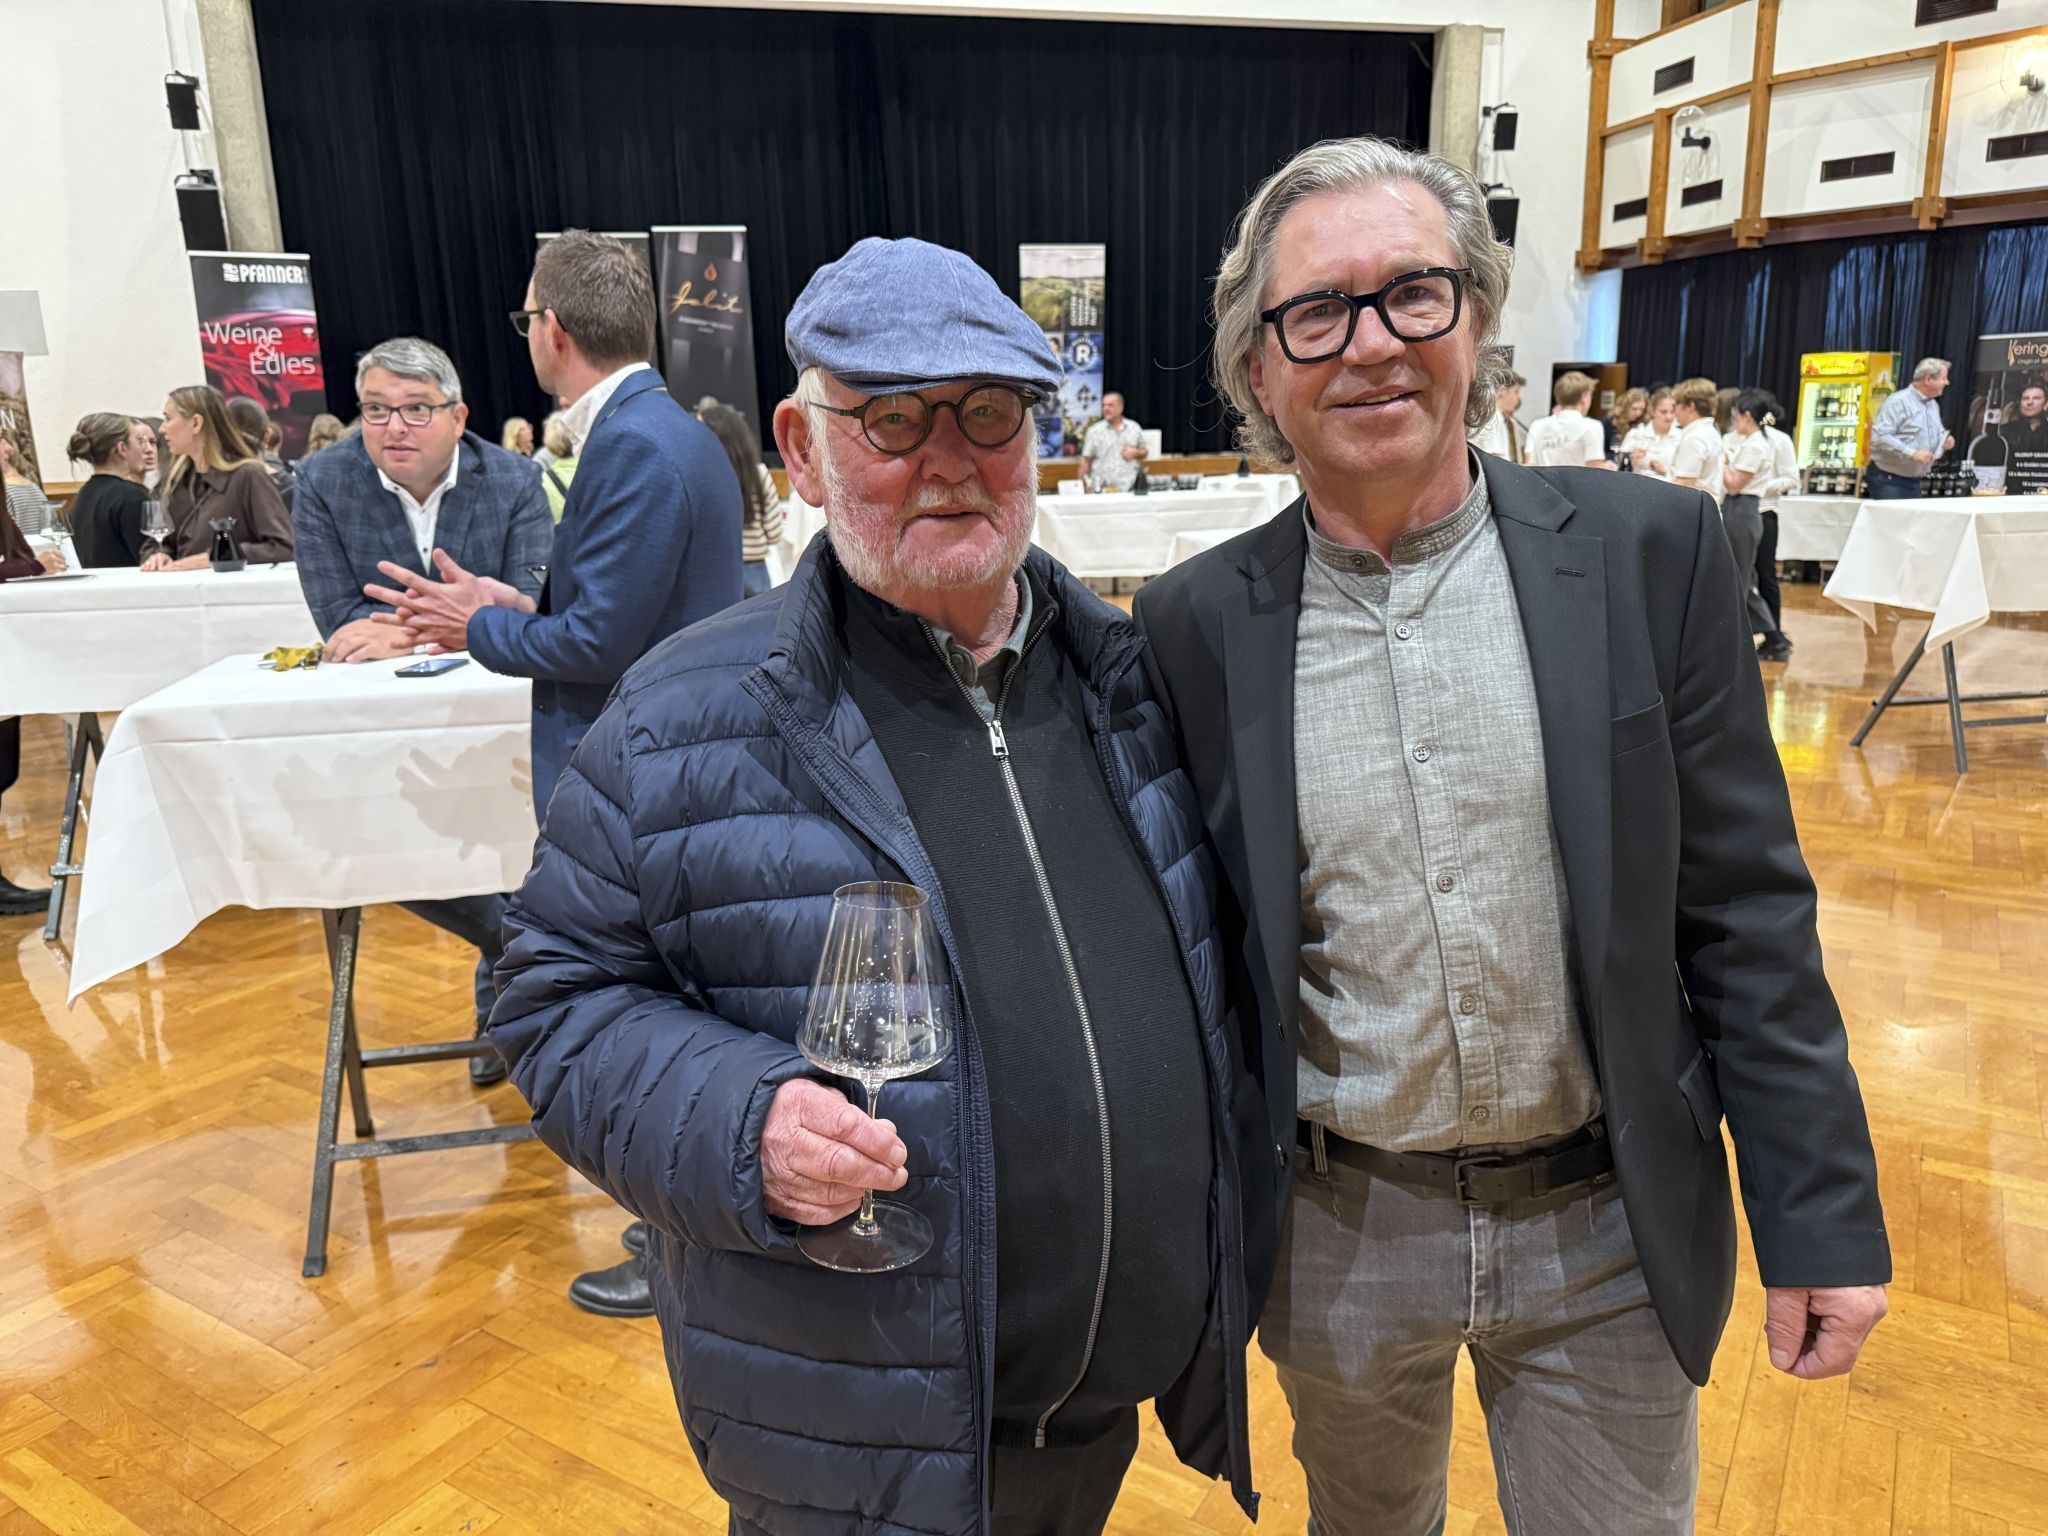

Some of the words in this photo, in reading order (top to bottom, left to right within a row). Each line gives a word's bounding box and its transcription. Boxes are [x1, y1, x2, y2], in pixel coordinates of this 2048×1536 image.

[239, 264, 303, 284] PFANNER
[203, 322, 283, 345] Weine
[254, 337, 275, 361] &
[1075, 344, 1091, 363] R
[249, 352, 316, 375] Edles
